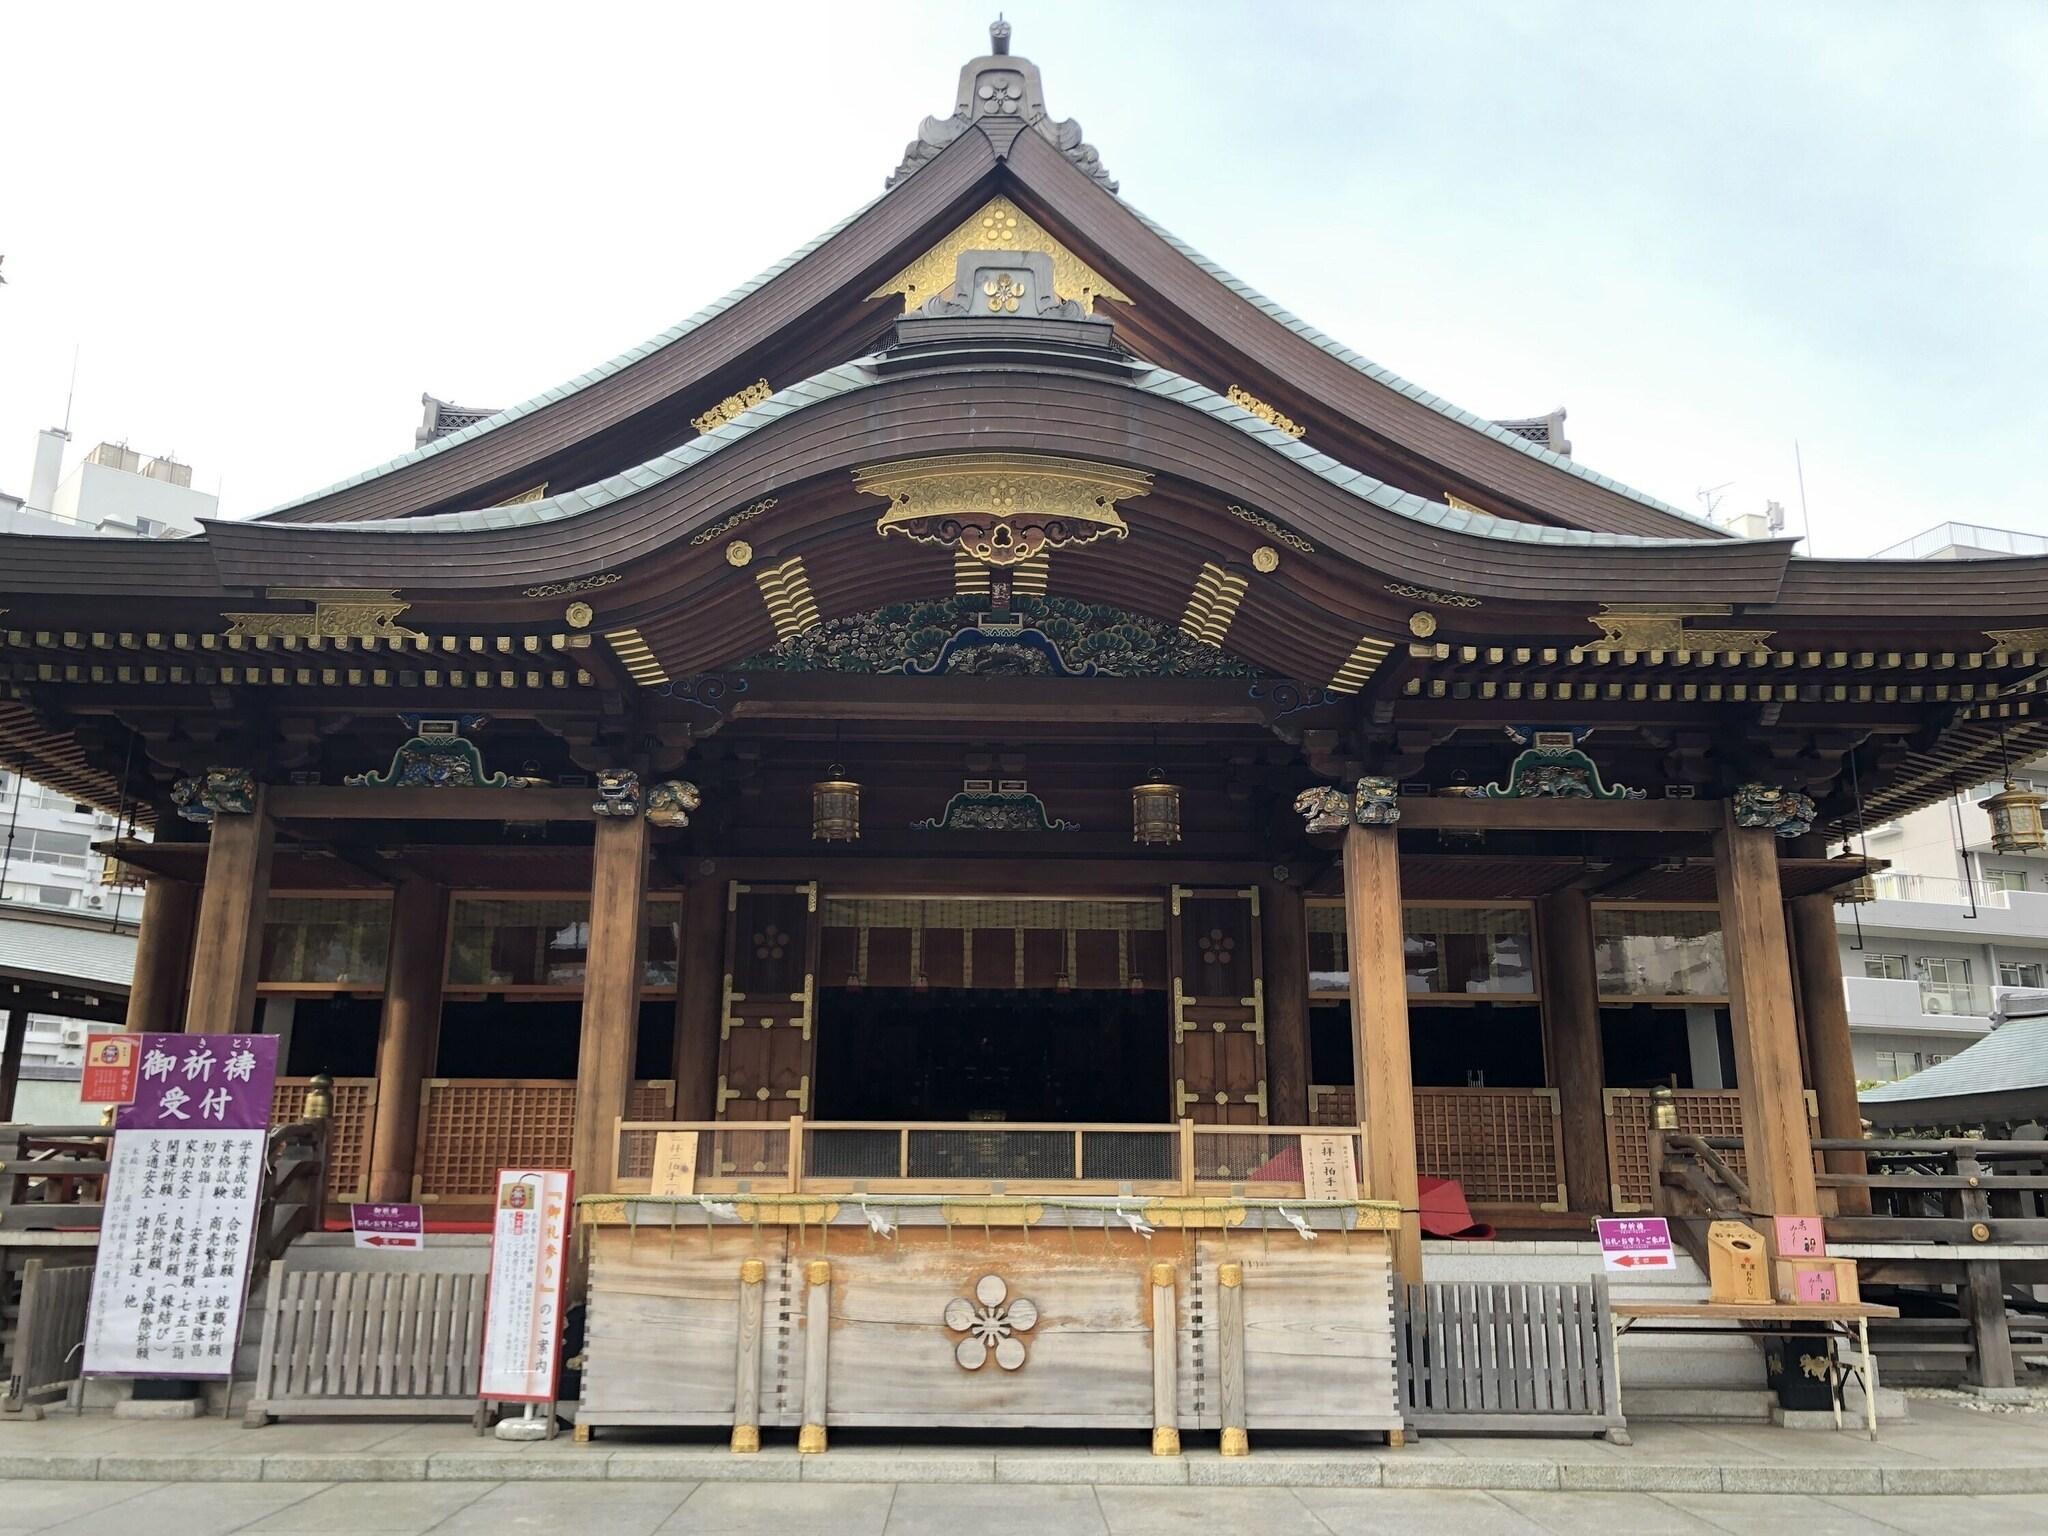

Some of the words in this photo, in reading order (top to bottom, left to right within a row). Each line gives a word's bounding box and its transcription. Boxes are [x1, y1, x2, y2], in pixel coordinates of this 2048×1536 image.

[141, 1049, 257, 1083] 御祈祷
[158, 1086, 233, 1121] 受付
